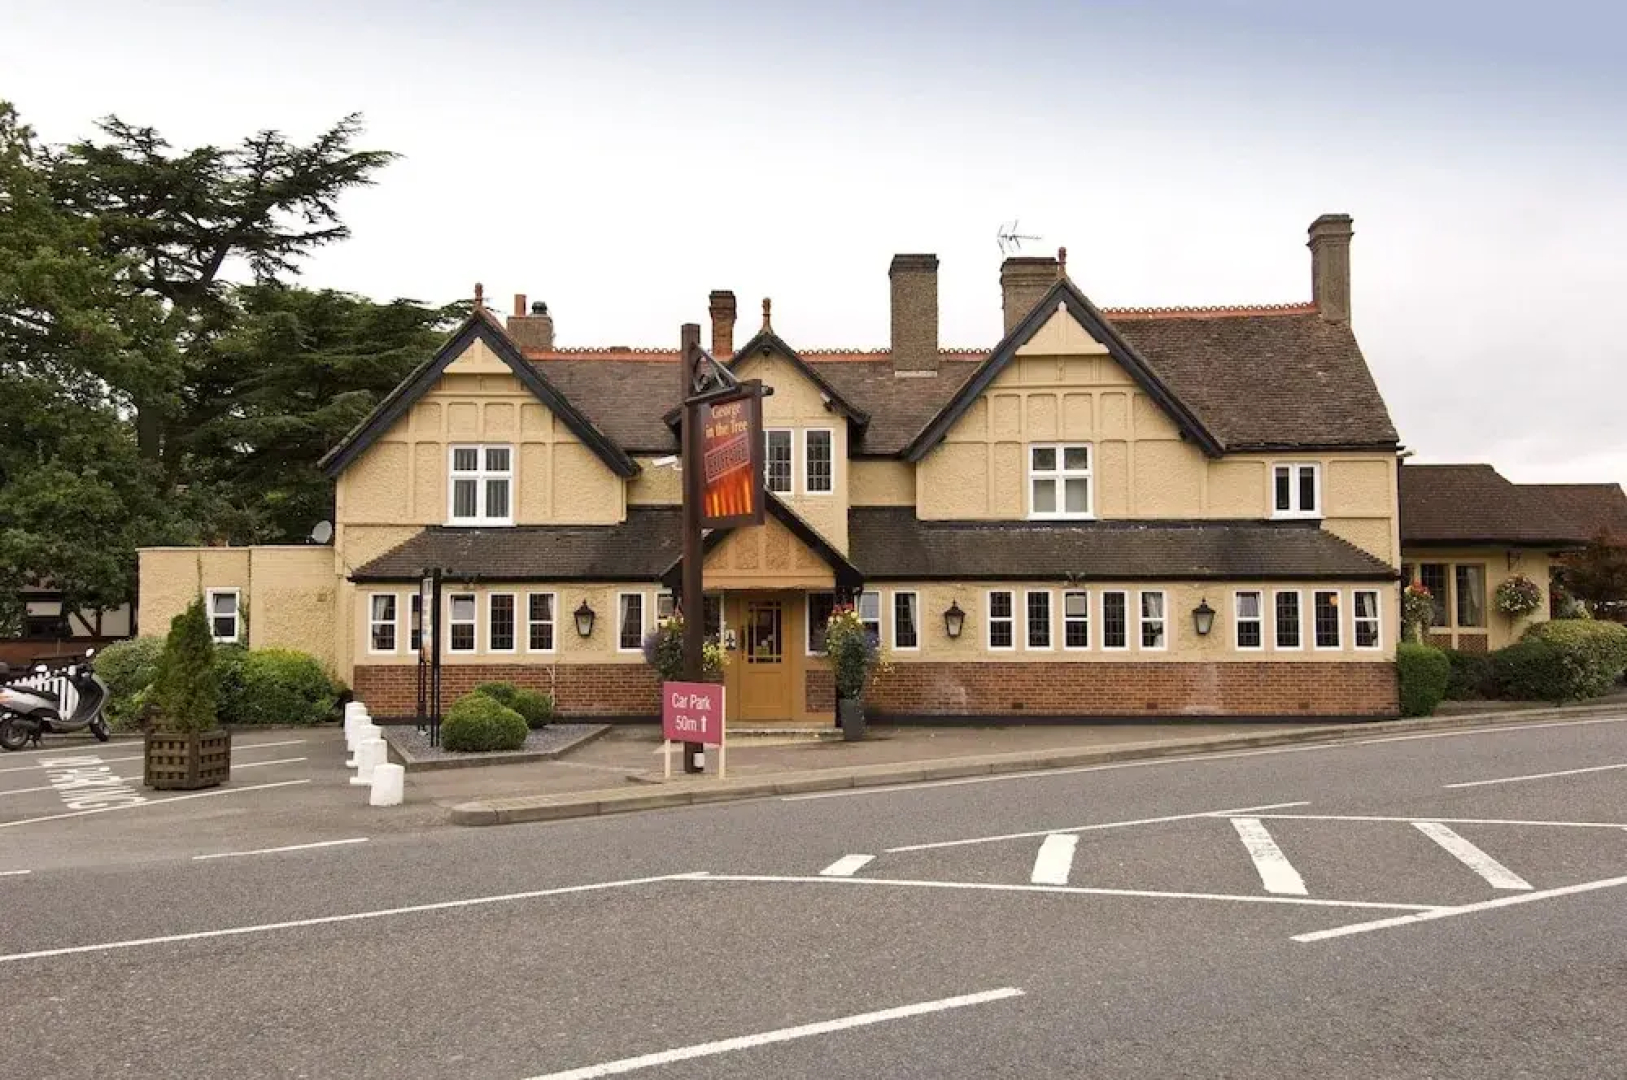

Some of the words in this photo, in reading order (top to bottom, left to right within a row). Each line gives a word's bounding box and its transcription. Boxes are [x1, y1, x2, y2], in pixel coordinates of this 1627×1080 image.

[712, 402, 742, 419] George
[705, 423, 715, 439] in
[715, 422, 730, 437] the
[730, 418, 748, 434] Tree
[672, 692, 688, 708] Car
[690, 694, 712, 710] Park
[674, 715, 697, 731] 50m
